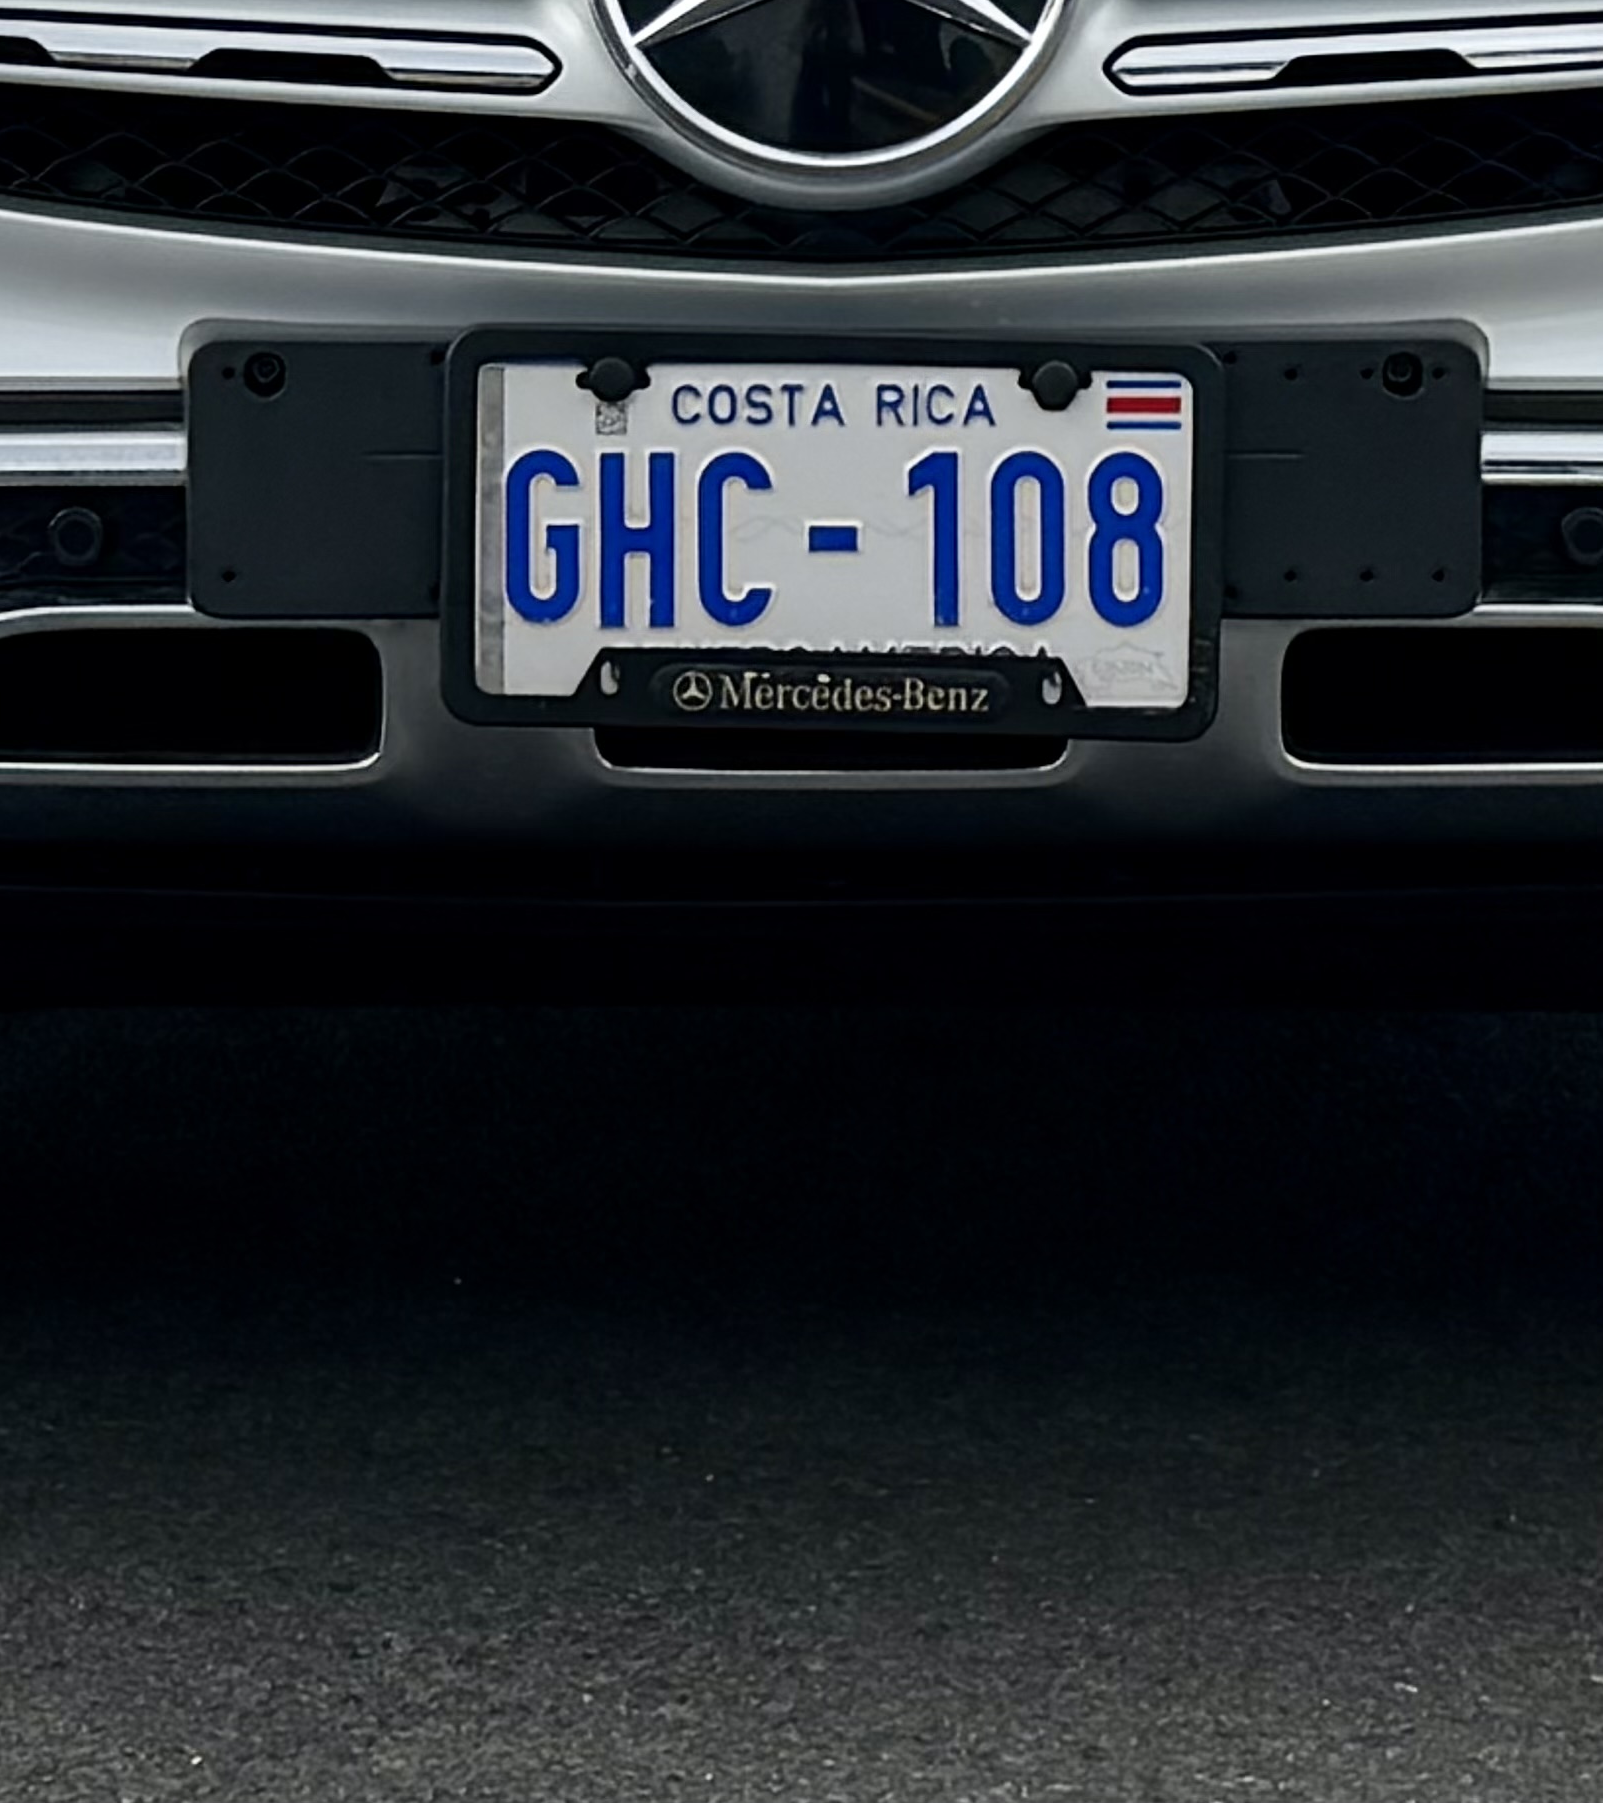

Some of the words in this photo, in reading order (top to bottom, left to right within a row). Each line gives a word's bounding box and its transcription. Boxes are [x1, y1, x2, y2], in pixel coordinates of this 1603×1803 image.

[671, 383, 846, 427] COSTA
[876, 383, 997, 427] RICA
[717, 671, 990, 712] Mercedes-Benz
